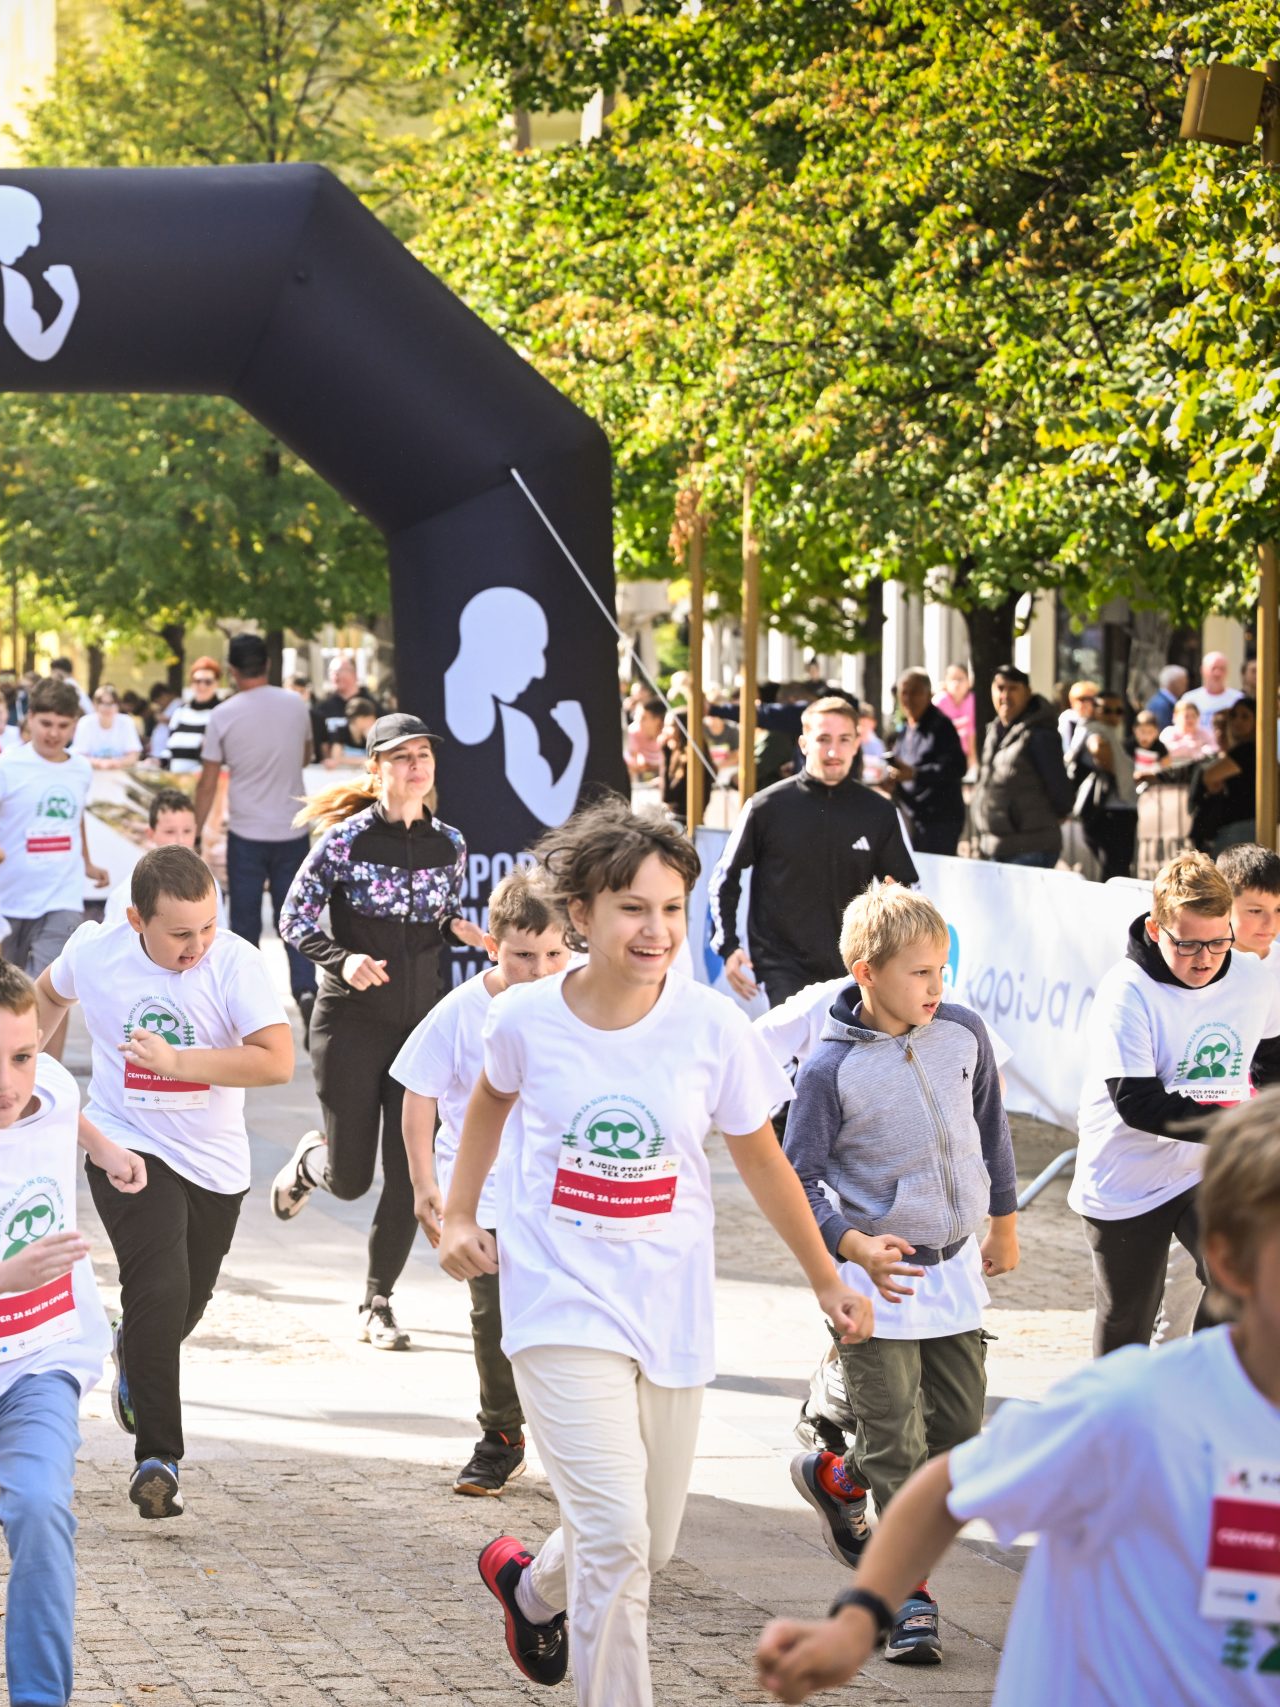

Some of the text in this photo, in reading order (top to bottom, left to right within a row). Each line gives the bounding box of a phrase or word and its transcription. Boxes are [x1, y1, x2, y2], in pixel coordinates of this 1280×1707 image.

[127, 1072, 151, 1080] CENTER
[589, 1160, 618, 1170] AJDIN
[602, 1170, 619, 1178] TEK
[558, 1186, 595, 1200] CENTER
[597, 1194, 609, 1202] ZA
[610, 1197, 633, 1205] SLUH
[12, 1312, 24, 1320] ZA
[41, 1300, 49, 1309] IN
